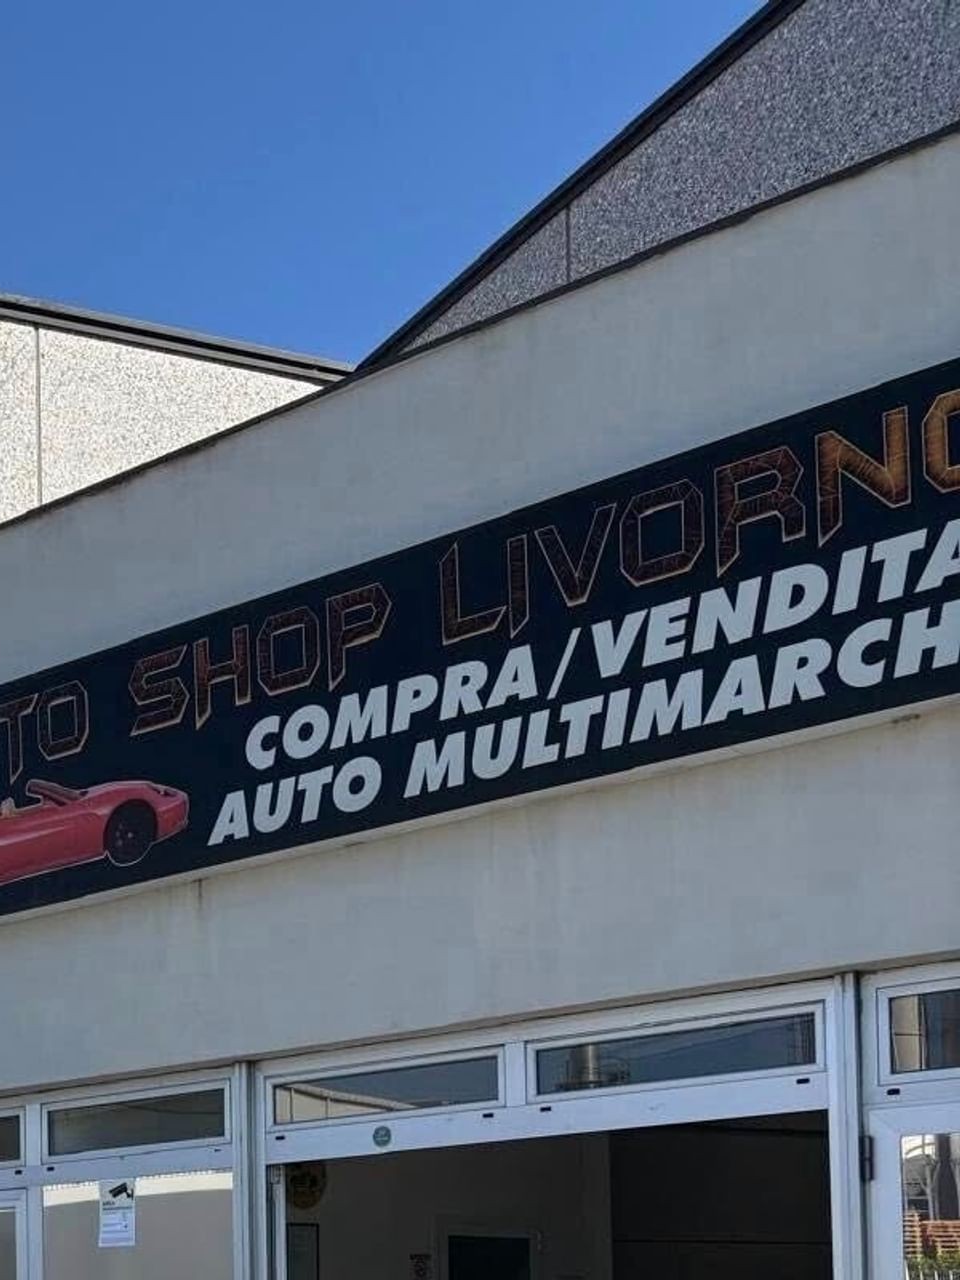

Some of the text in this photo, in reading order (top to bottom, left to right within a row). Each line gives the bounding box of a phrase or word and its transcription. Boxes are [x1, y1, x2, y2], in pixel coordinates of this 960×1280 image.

[128, 582, 392, 737] SHOP
[245, 517, 960, 770] COMPRA/VENDITA
[207, 756, 382, 847] AUTO
